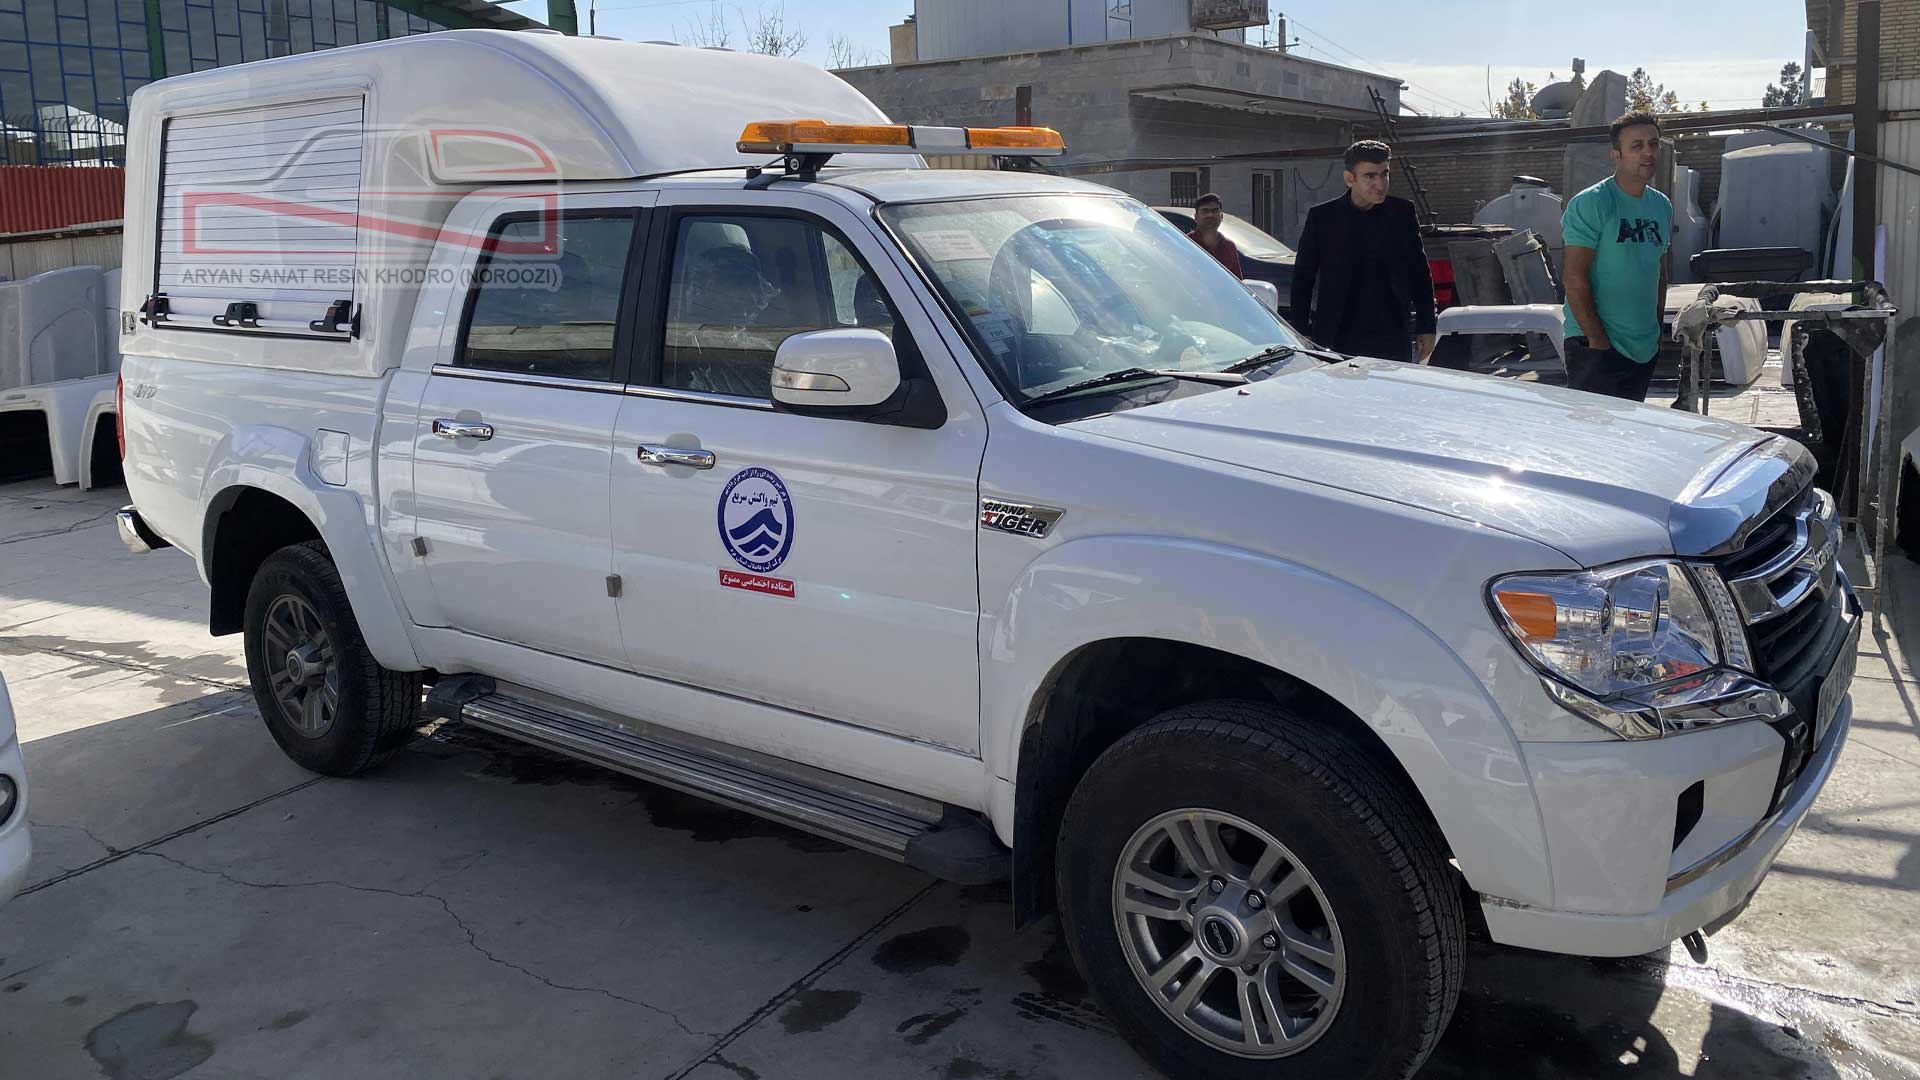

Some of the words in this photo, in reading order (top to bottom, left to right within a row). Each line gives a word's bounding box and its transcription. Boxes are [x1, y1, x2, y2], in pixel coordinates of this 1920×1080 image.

[732, 493, 747, 504] سریع
[748, 490, 770, 507] واکنش
[983, 502, 1026, 515] GRAND
[982, 511, 1047, 534] TIGER
[722, 574, 740, 585] ممنوع
[741, 577, 770, 588] اختصاصی
[770, 582, 793, 592] استفاده
